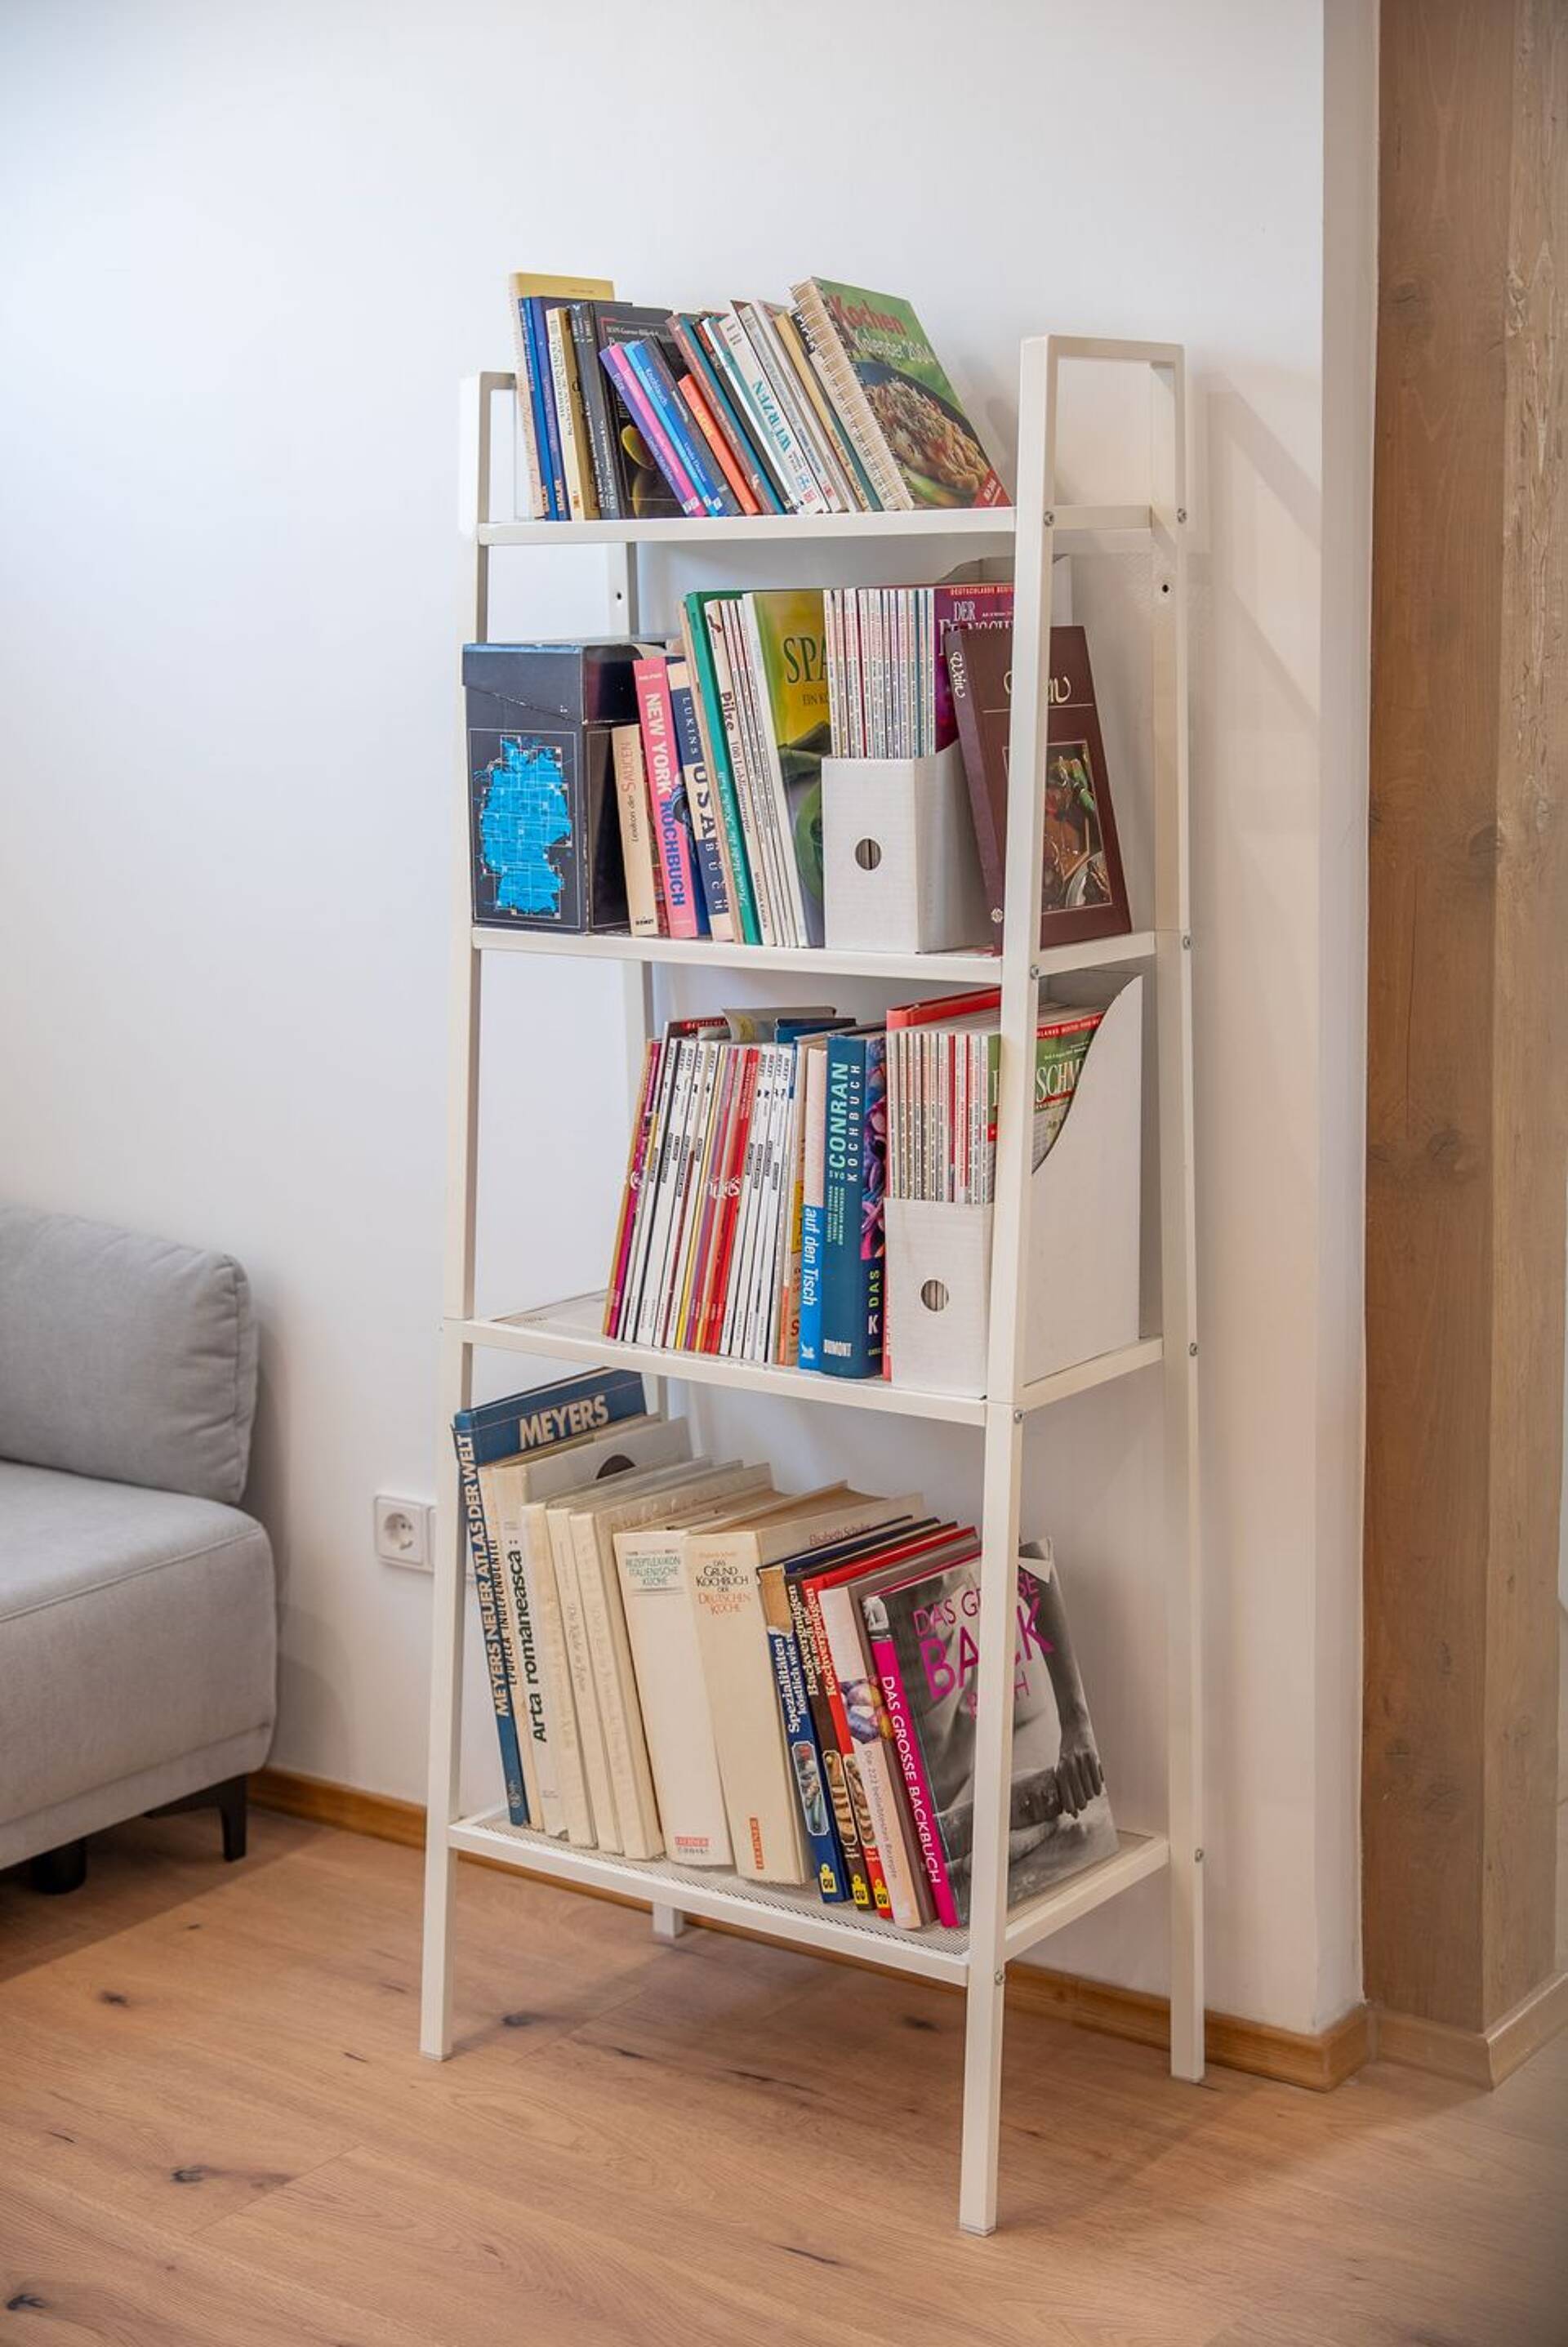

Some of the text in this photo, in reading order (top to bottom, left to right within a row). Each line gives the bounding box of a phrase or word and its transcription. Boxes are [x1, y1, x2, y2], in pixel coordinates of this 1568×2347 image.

[953, 601, 975, 621] DER
[680, 696, 698, 755] LUKINS
[720, 690, 735, 732] Pilze
[620, 742, 639, 842] Lexikon der SAUCEN
[644, 692, 686, 907] NEW YORK KOCHBUCH
[693, 766, 715, 839] USA
[829, 1062, 849, 1168] CONRAN
[847, 1065, 860, 1182] KOCHBUCH
[803, 1207, 821, 1307] auf den Tisch
[868, 1270, 881, 1307] DAS
[519, 1394, 609, 1450] MEYERS
[457, 1435, 510, 1717] MEYERS NEUER ATLAS DER WELT
[696, 1576, 749, 1588] KOCHBUCH
[703, 1565, 738, 1577] GRUND
[788, 1584, 819, 1696] Backvergnügen
[805, 1588, 838, 1697] Kochvergnügen
[912, 1599, 956, 1637] DAS
[919, 1593, 1054, 1701] BAK
[774, 1638, 800, 1734] Spezialitäten
[786, 1648, 798, 1666] wie
[529, 1693, 547, 1743] Arta
[863, 1749, 872, 1766] Die
[881, 1676, 941, 1884] DAS GROSSE BACKBUCH
